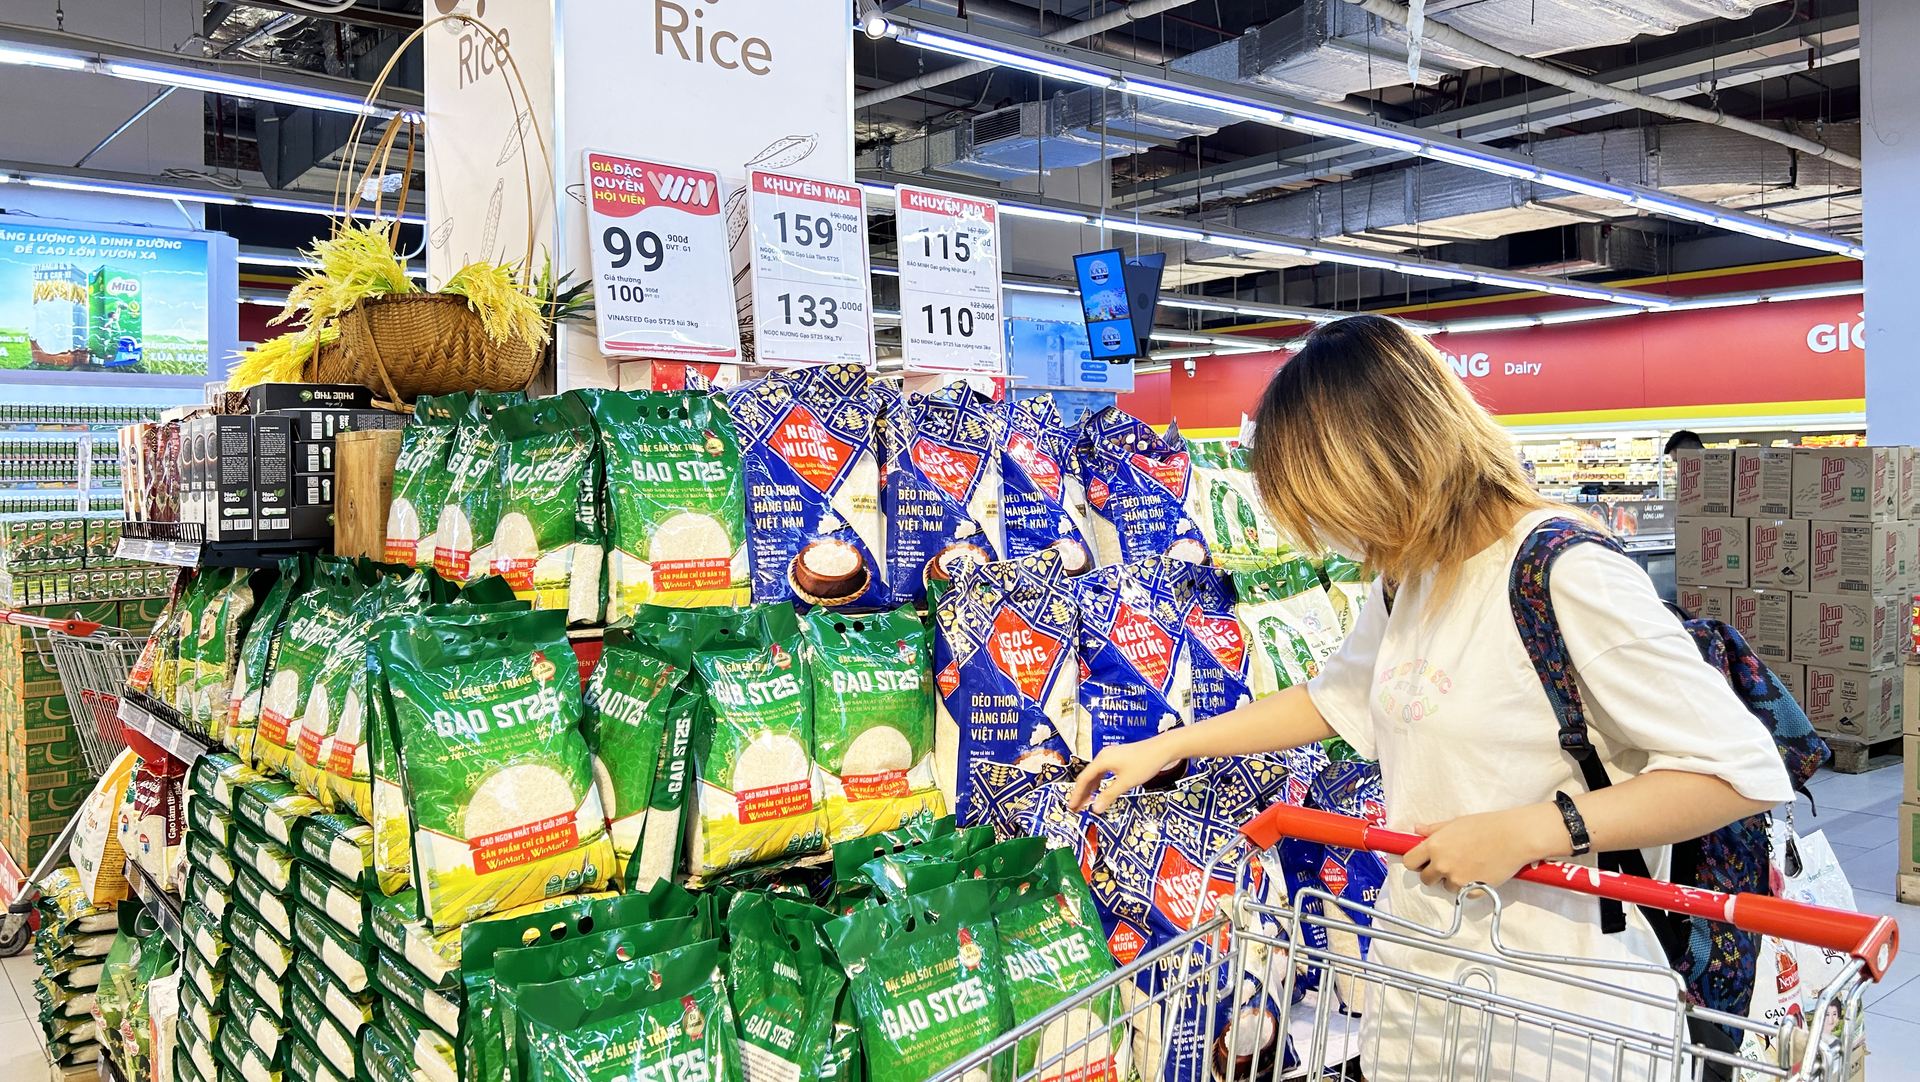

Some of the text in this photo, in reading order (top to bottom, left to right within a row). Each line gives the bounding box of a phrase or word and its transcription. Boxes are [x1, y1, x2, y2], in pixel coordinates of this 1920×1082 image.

[655, 1, 772, 76] Rice
[459, 27, 510, 90] Rice
[592, 161, 643, 178] GIÁ ĐẶC
[593, 176, 645, 193] QUYỀN
[763, 177, 850, 203] KHUYẾN MẠI
[595, 190, 646, 205] HỘI VIÊN
[910, 194, 960, 214] KHUYẾN
[773, 211, 858, 248] 159 .900đ
[29, 232, 182, 250] LƯỢNG VÀ DINH DƯỠNG
[603, 226, 664, 272] 99
[918, 227, 971, 262] 115
[14, 242, 157, 260] ĐỂ CAO LỚN VƯƠN XA
[111, 282, 137, 292] MILO
[604, 273, 642, 285] Giá thường
[607, 283, 645, 303] 100
[777, 292, 863, 329] 133 .000đ
[607, 314, 699, 329] VINASEED Gạo ST25 túi 3kg
[921, 303, 995, 338] 110 .300đ
[763, 329, 779, 337] NGỌC
[1504, 361, 1542, 376] Dairy
[785, 423, 828, 444] NGỌC
[784, 441, 838, 463] NƯƠNG
[631, 460, 727, 486] GẠO ST25
[752, 481, 774, 497] DẺO
[754, 497, 803, 514] HÀNG ĐẦU
[898, 502, 943, 517] HÀNG ĐẦU
[1005, 505, 1029, 517] HÀNG
[755, 514, 804, 531] VIỆT NAM
[897, 519, 943, 534] VIỆT NAM
[1029, 519, 1048, 529] NAM
[1148, 521, 1166, 532] NAM
[659, 570, 689, 580] SẢN PHẨM
[1115, 621, 1155, 644] NGỌC
[748, 673, 800, 706] ST25
[832, 669, 919, 698] GẠO ST25
[971, 692, 1018, 707] DẺO THƠM
[434, 686, 561, 740] GẠO ST25
[971, 708, 1019, 724] HÀNG ĐẦU
[1127, 716, 1147, 727] NAM
[971, 726, 1018, 743] VIỆT NAM
[667, 717, 692, 793] GẠO ST25
[167, 822, 178, 839] Gạo
[480, 815, 569, 848] GẠO NGON NHẤT THẾ GIỚI 2019
[480, 827, 572, 860] SẢN PHẨM CHỈ CÓ BÁN TẠI
[486, 853, 526, 871] WinMart
[1112, 940, 1138, 952] NƯƠNG
[1114, 932, 1135, 943] NGỌC
[1038, 932, 1091, 971] ST25
[885, 957, 960, 993] ĐẶC SẢN SÓC TRĂNG
[882, 976, 989, 1041] GẠO ST25
[746, 1014, 795, 1050] GẠO ST25
[607, 1024, 683, 1062] SẢN TRĂNG
